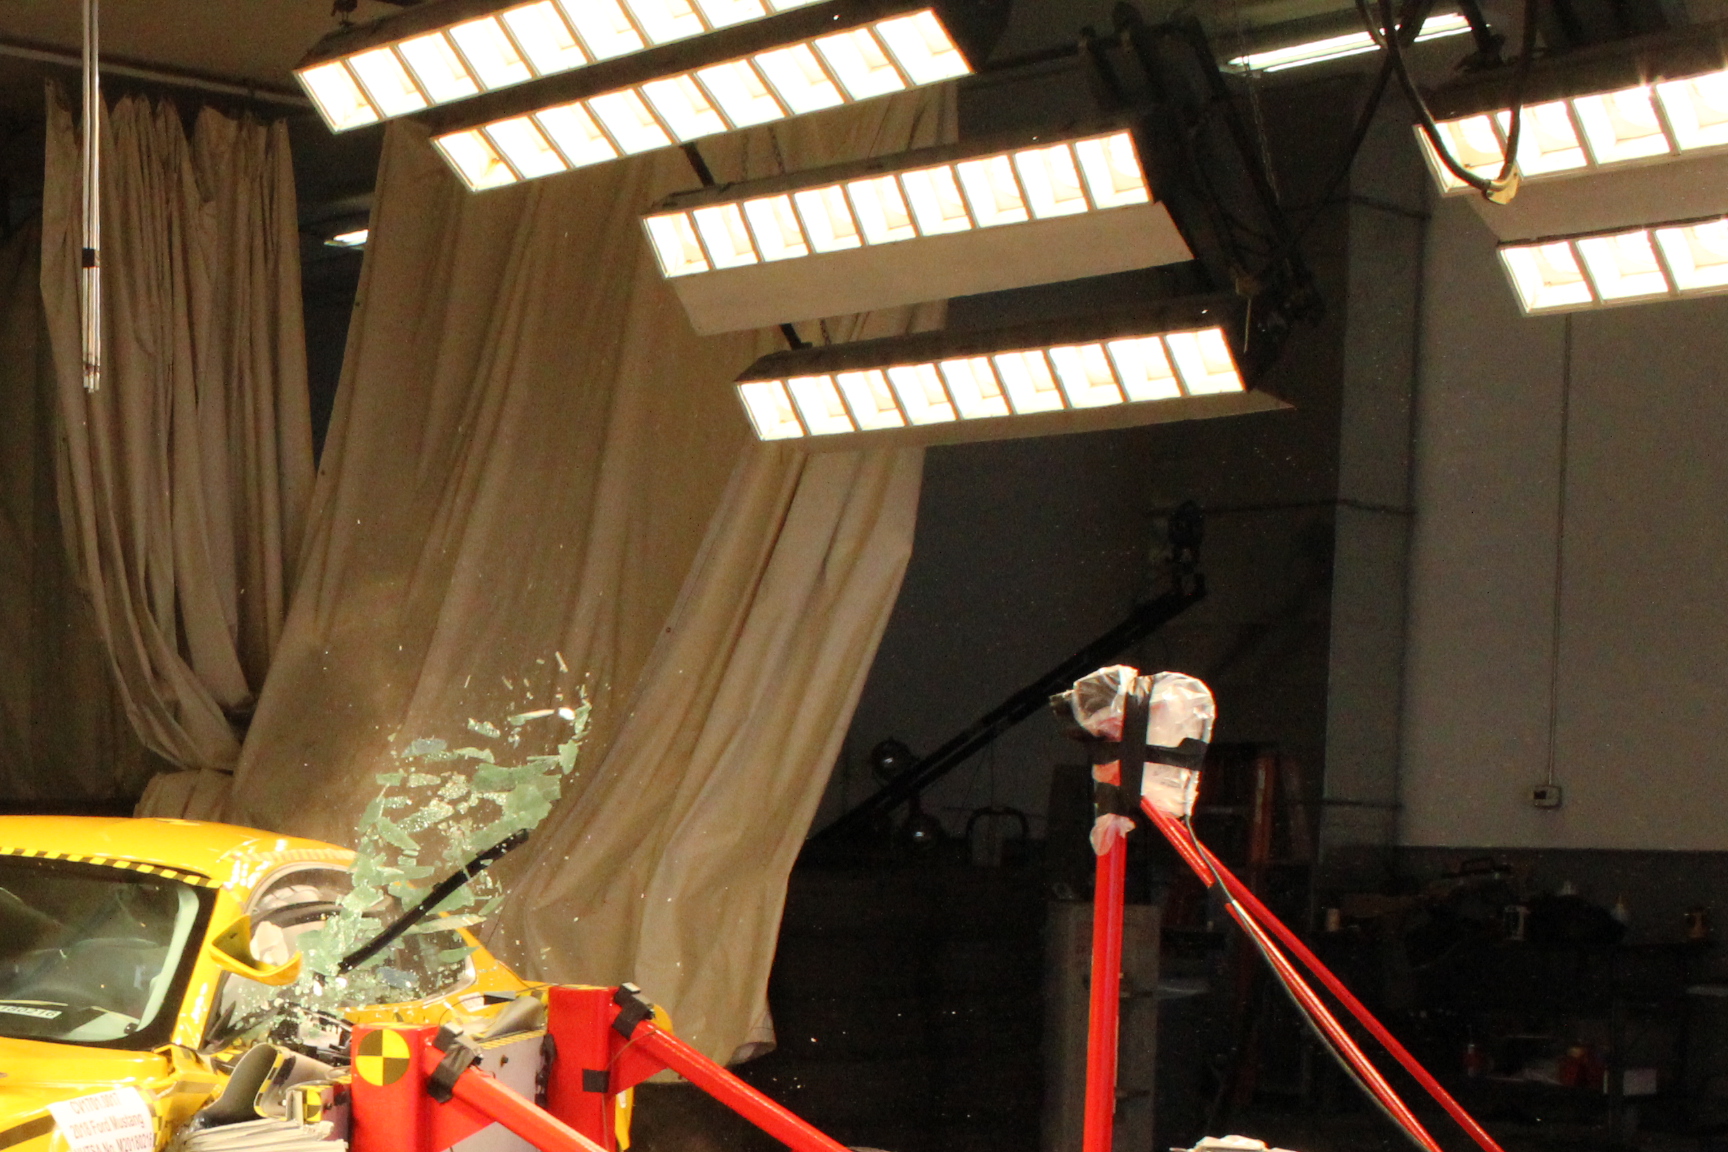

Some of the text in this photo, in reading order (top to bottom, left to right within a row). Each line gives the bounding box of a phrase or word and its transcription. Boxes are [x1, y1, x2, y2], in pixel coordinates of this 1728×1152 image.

[69, 1113, 145, 1140] 2018 Ford Mustang
